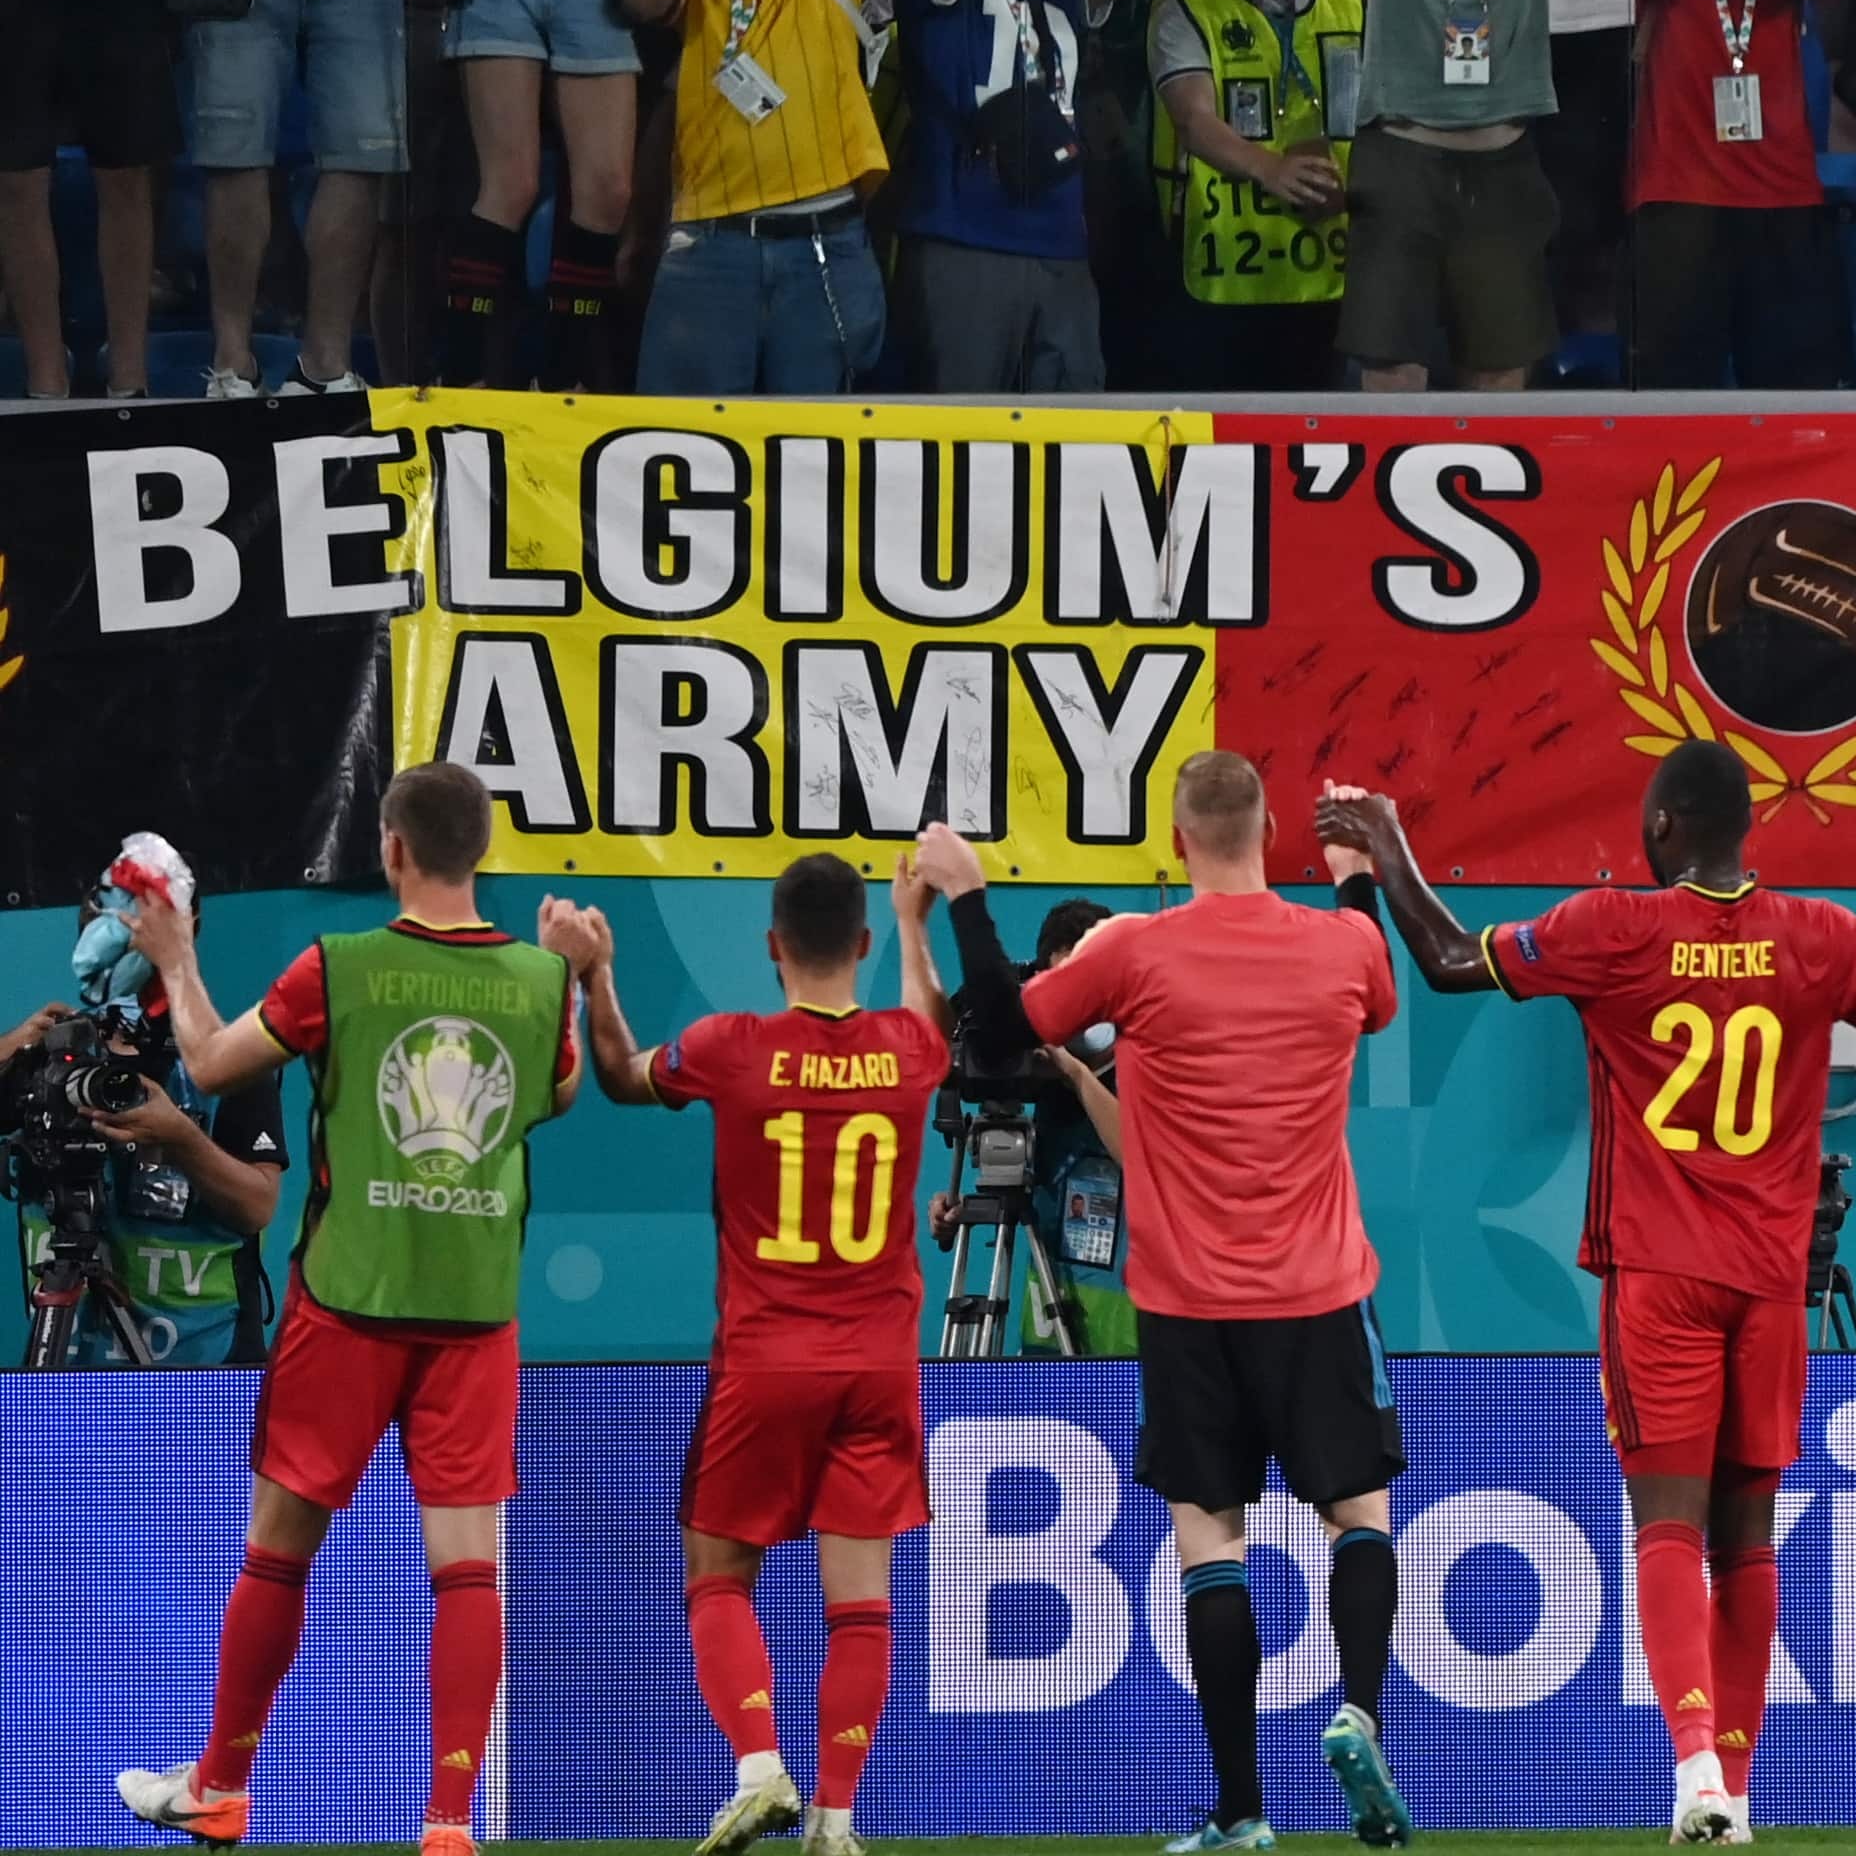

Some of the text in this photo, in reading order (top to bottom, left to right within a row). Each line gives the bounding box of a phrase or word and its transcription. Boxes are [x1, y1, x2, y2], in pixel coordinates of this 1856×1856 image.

[86, 426, 1542, 634] BELGIUM'S
[430, 631, 1206, 846] ARMY
[1671, 939, 1776, 979] BENTEKE
[366, 967, 531, 1016] VERTONGHEN
[770, 1051, 900, 1090] E. HAZARD
[1643, 1001, 1784, 1157] 20
[367, 1178, 508, 1218] EURO2020
[756, 1111, 898, 1265] 10
[137, 1245, 217, 1297] TV
